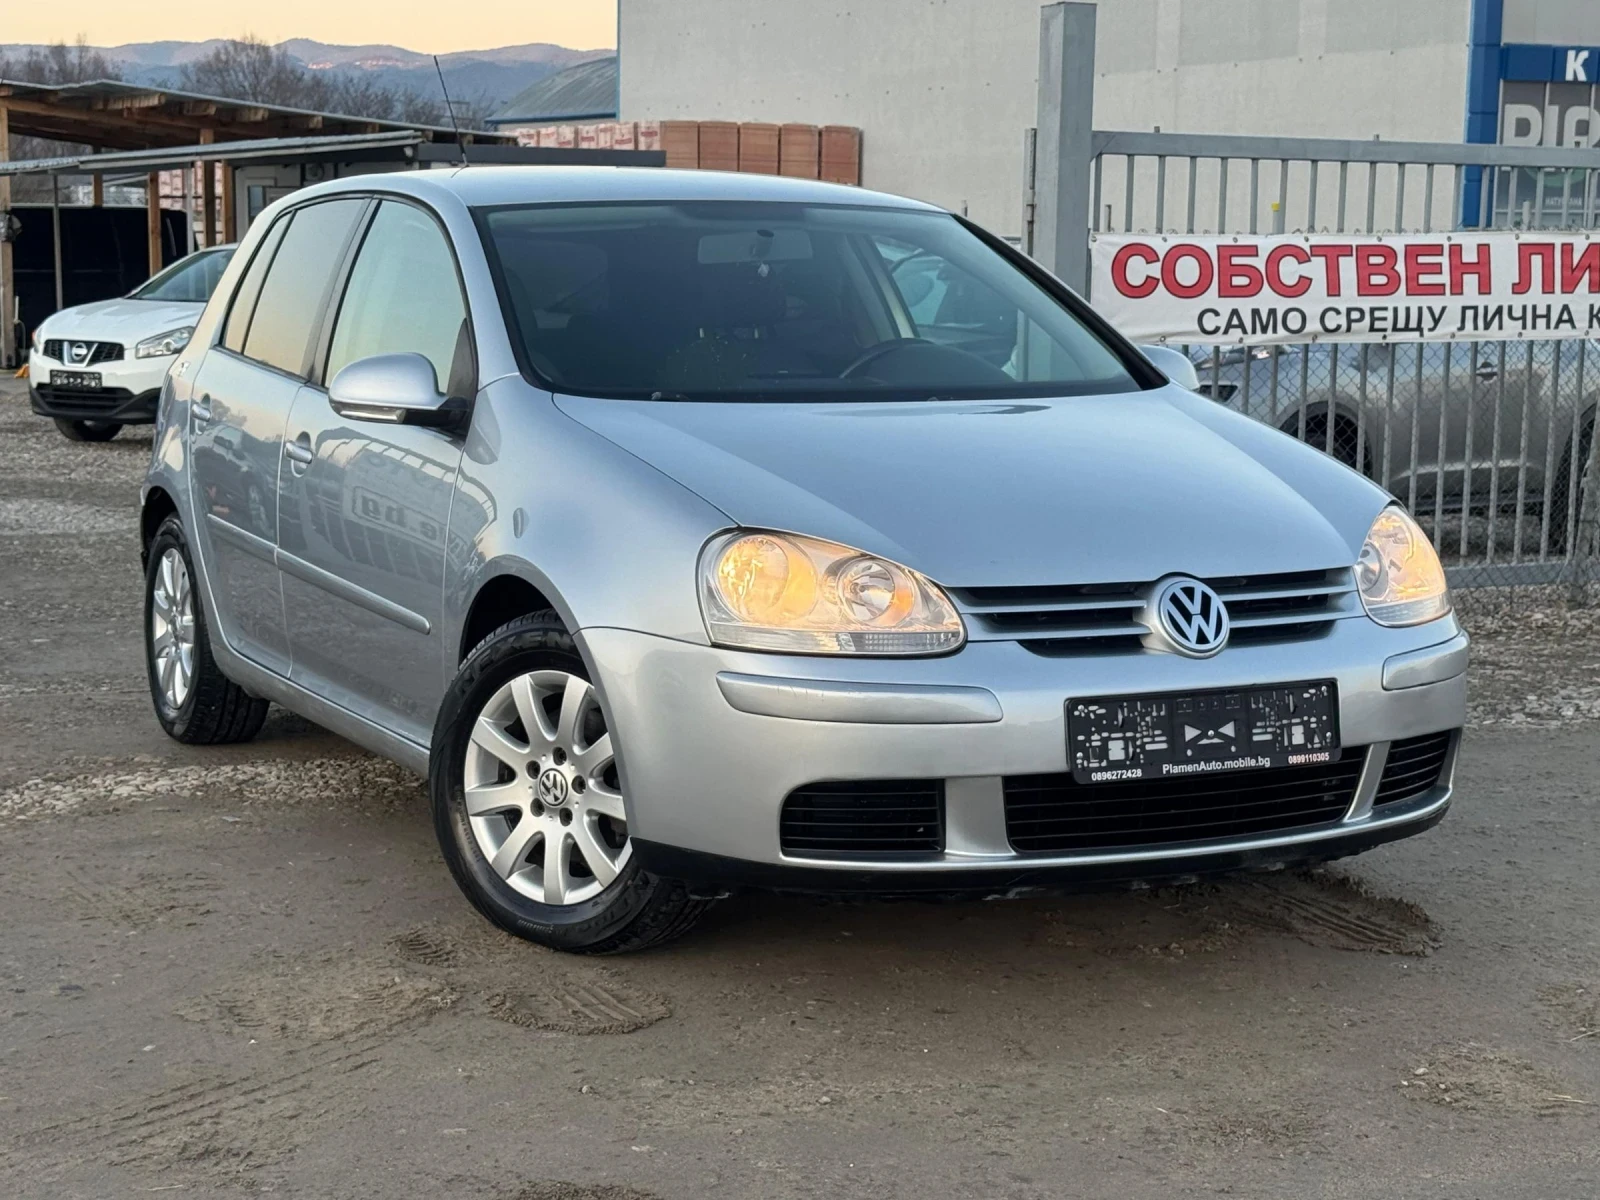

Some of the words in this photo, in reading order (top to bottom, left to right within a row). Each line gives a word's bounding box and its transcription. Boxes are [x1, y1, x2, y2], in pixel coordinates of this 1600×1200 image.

[1111, 242, 1492, 299] СОБСТВЕН
[1511, 243, 1600, 295] ЛИ
[1197, 307, 1307, 335] САМО
[1319, 305, 1448, 337] СРЕЩУ
[1457, 303, 1577, 332] ЛИЧНА
[1162, 755, 1271, 775] PlamenAuto.mobile.bg
[1287, 752, 1331, 765] 0899110305
[1091, 768, 1143, 782] 0896272428
